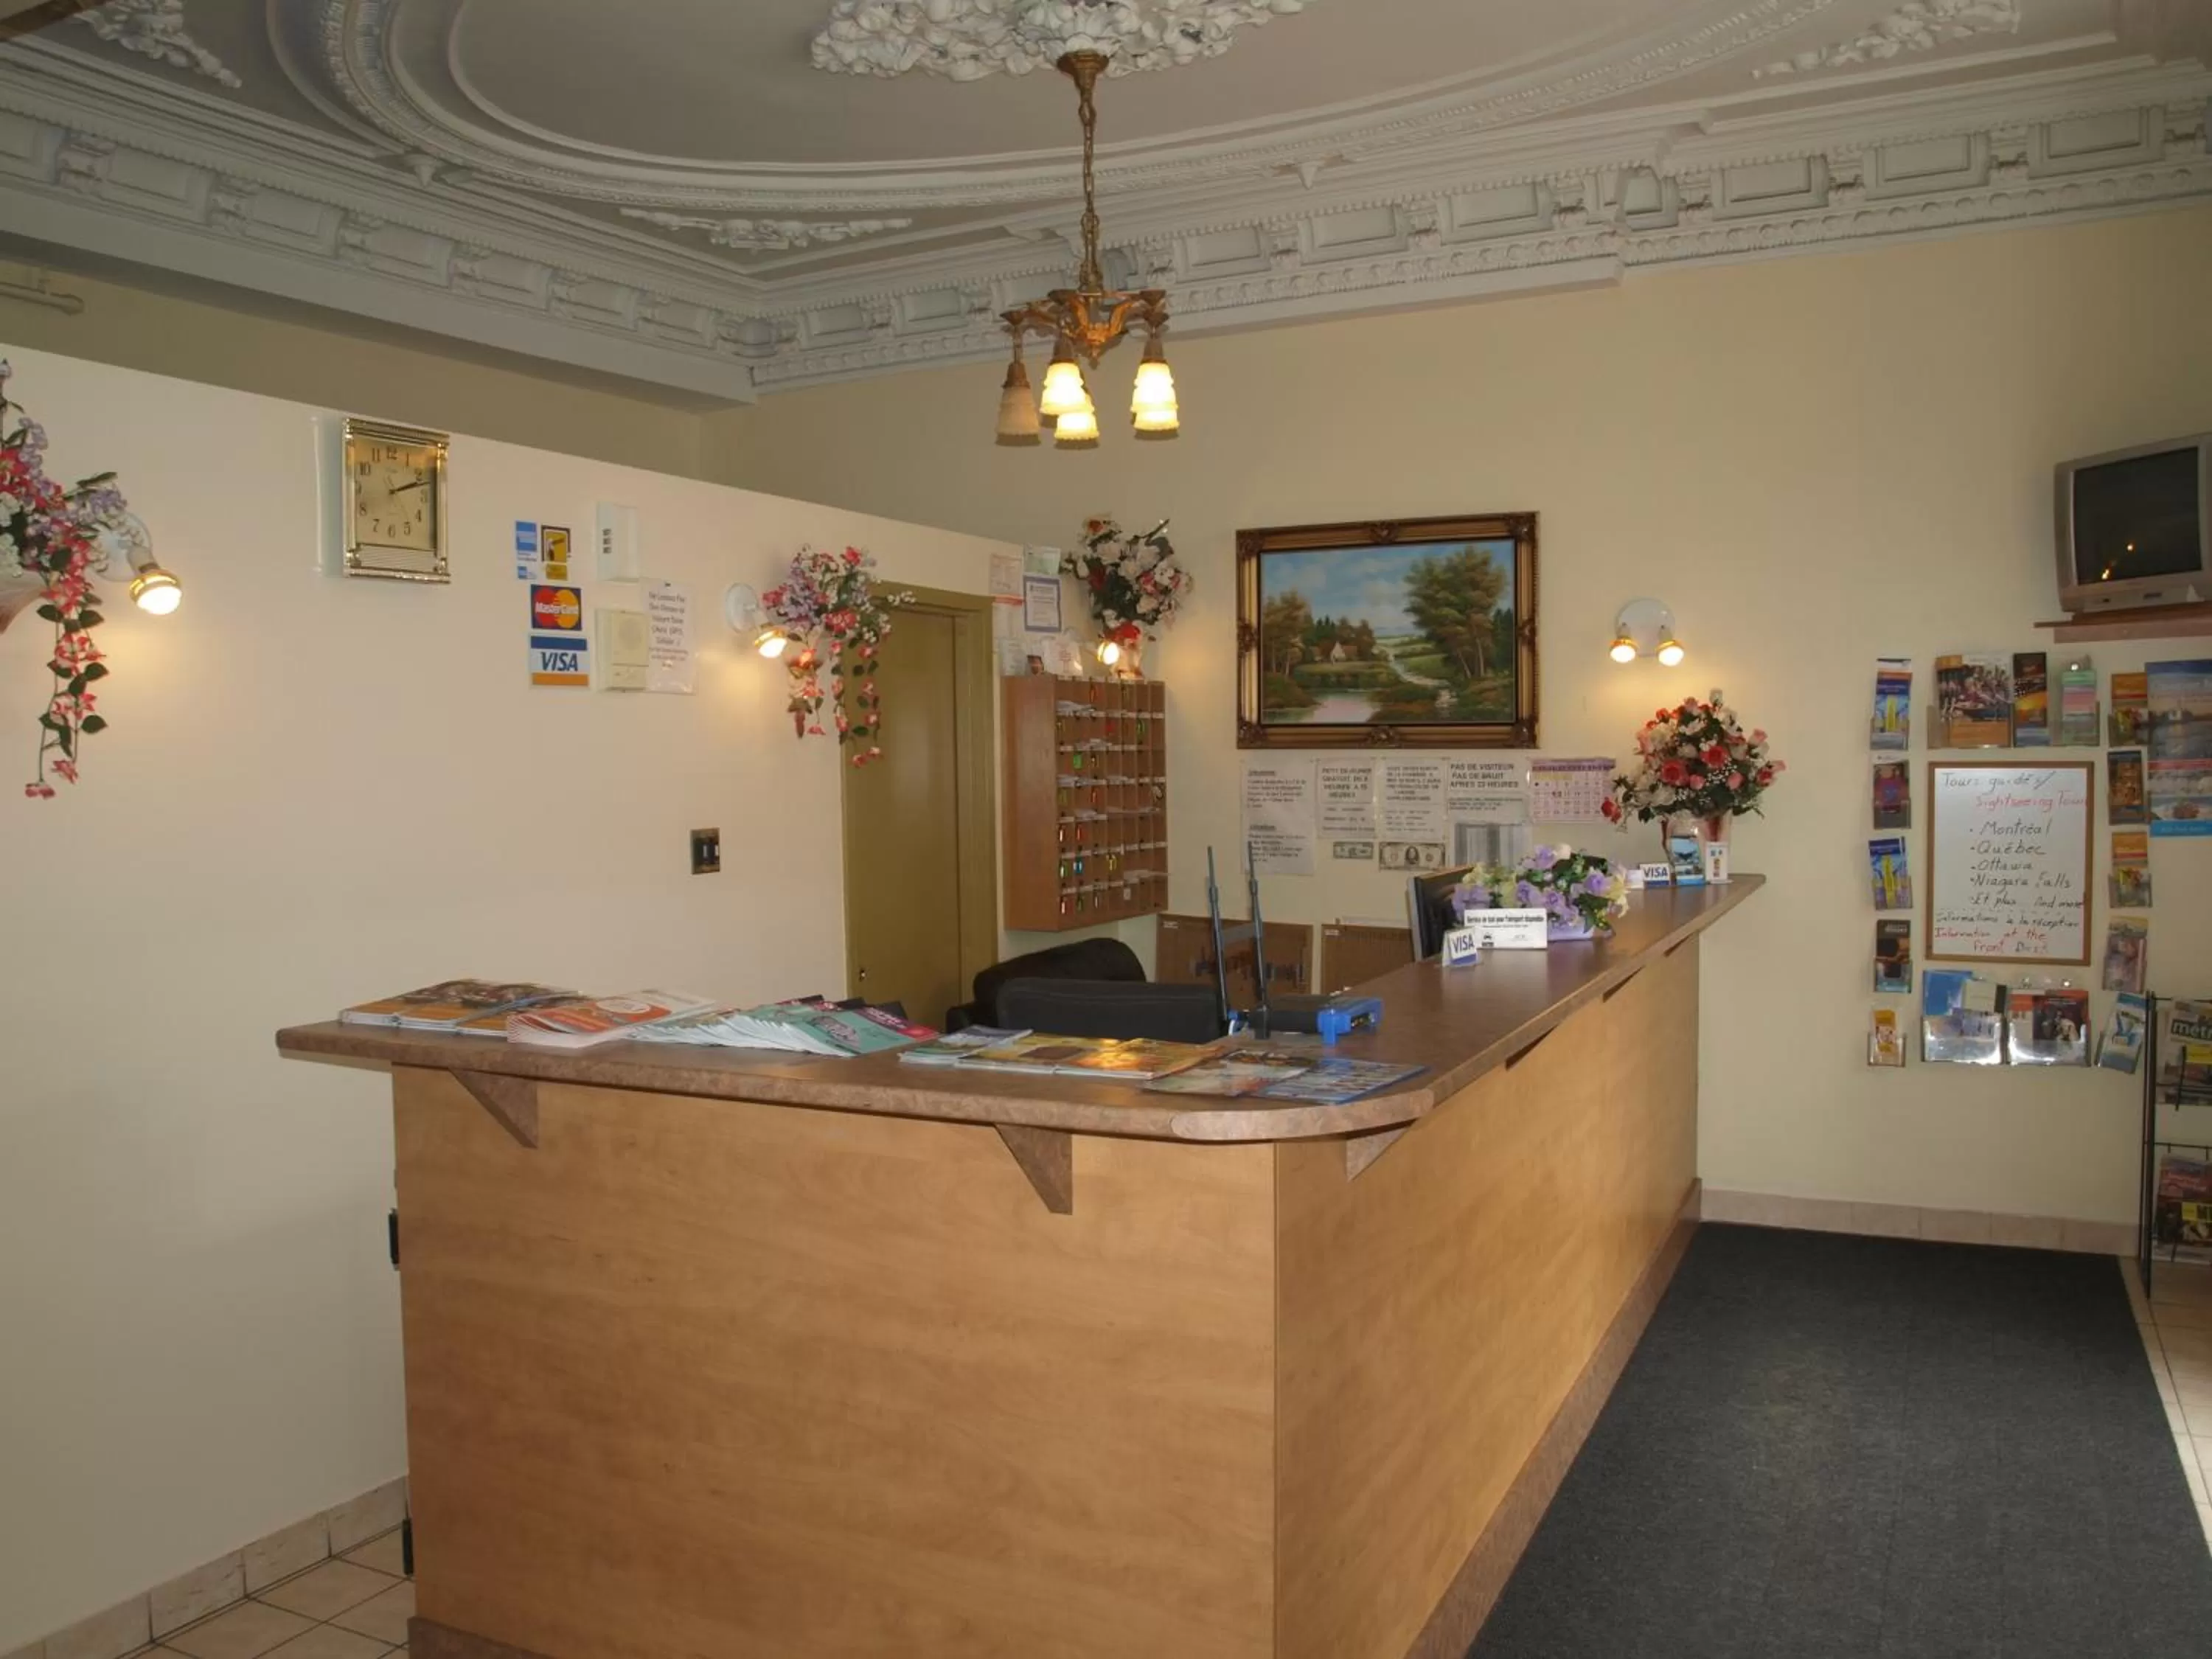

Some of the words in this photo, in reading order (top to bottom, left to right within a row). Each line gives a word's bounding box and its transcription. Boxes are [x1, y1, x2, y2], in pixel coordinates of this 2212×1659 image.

[371, 448, 380, 462] 11
[386, 446, 397, 461] 12
[406, 453, 410, 467] 1
[360, 462, 371, 476] 10
[414, 469, 423, 482] 2
[359, 503, 367, 517] 8
[415, 509, 422, 523] 4
[372, 518, 380, 532] 7
[388, 524, 396, 538] 6
[403, 522, 411, 535] 5
[535, 602, 579, 614] MasterCard
[540, 651, 579, 672] VISA
[1980, 818, 2053, 838] Montréal
[1977, 840, 2048, 855] Québec
[1978, 858, 2034, 871] Ottawa
[1644, 865, 1669, 879] VISA
[1974, 873, 2029, 893] Niagara
[2035, 872, 2072, 888] Falls
[1452, 933, 1475, 955] VISA
